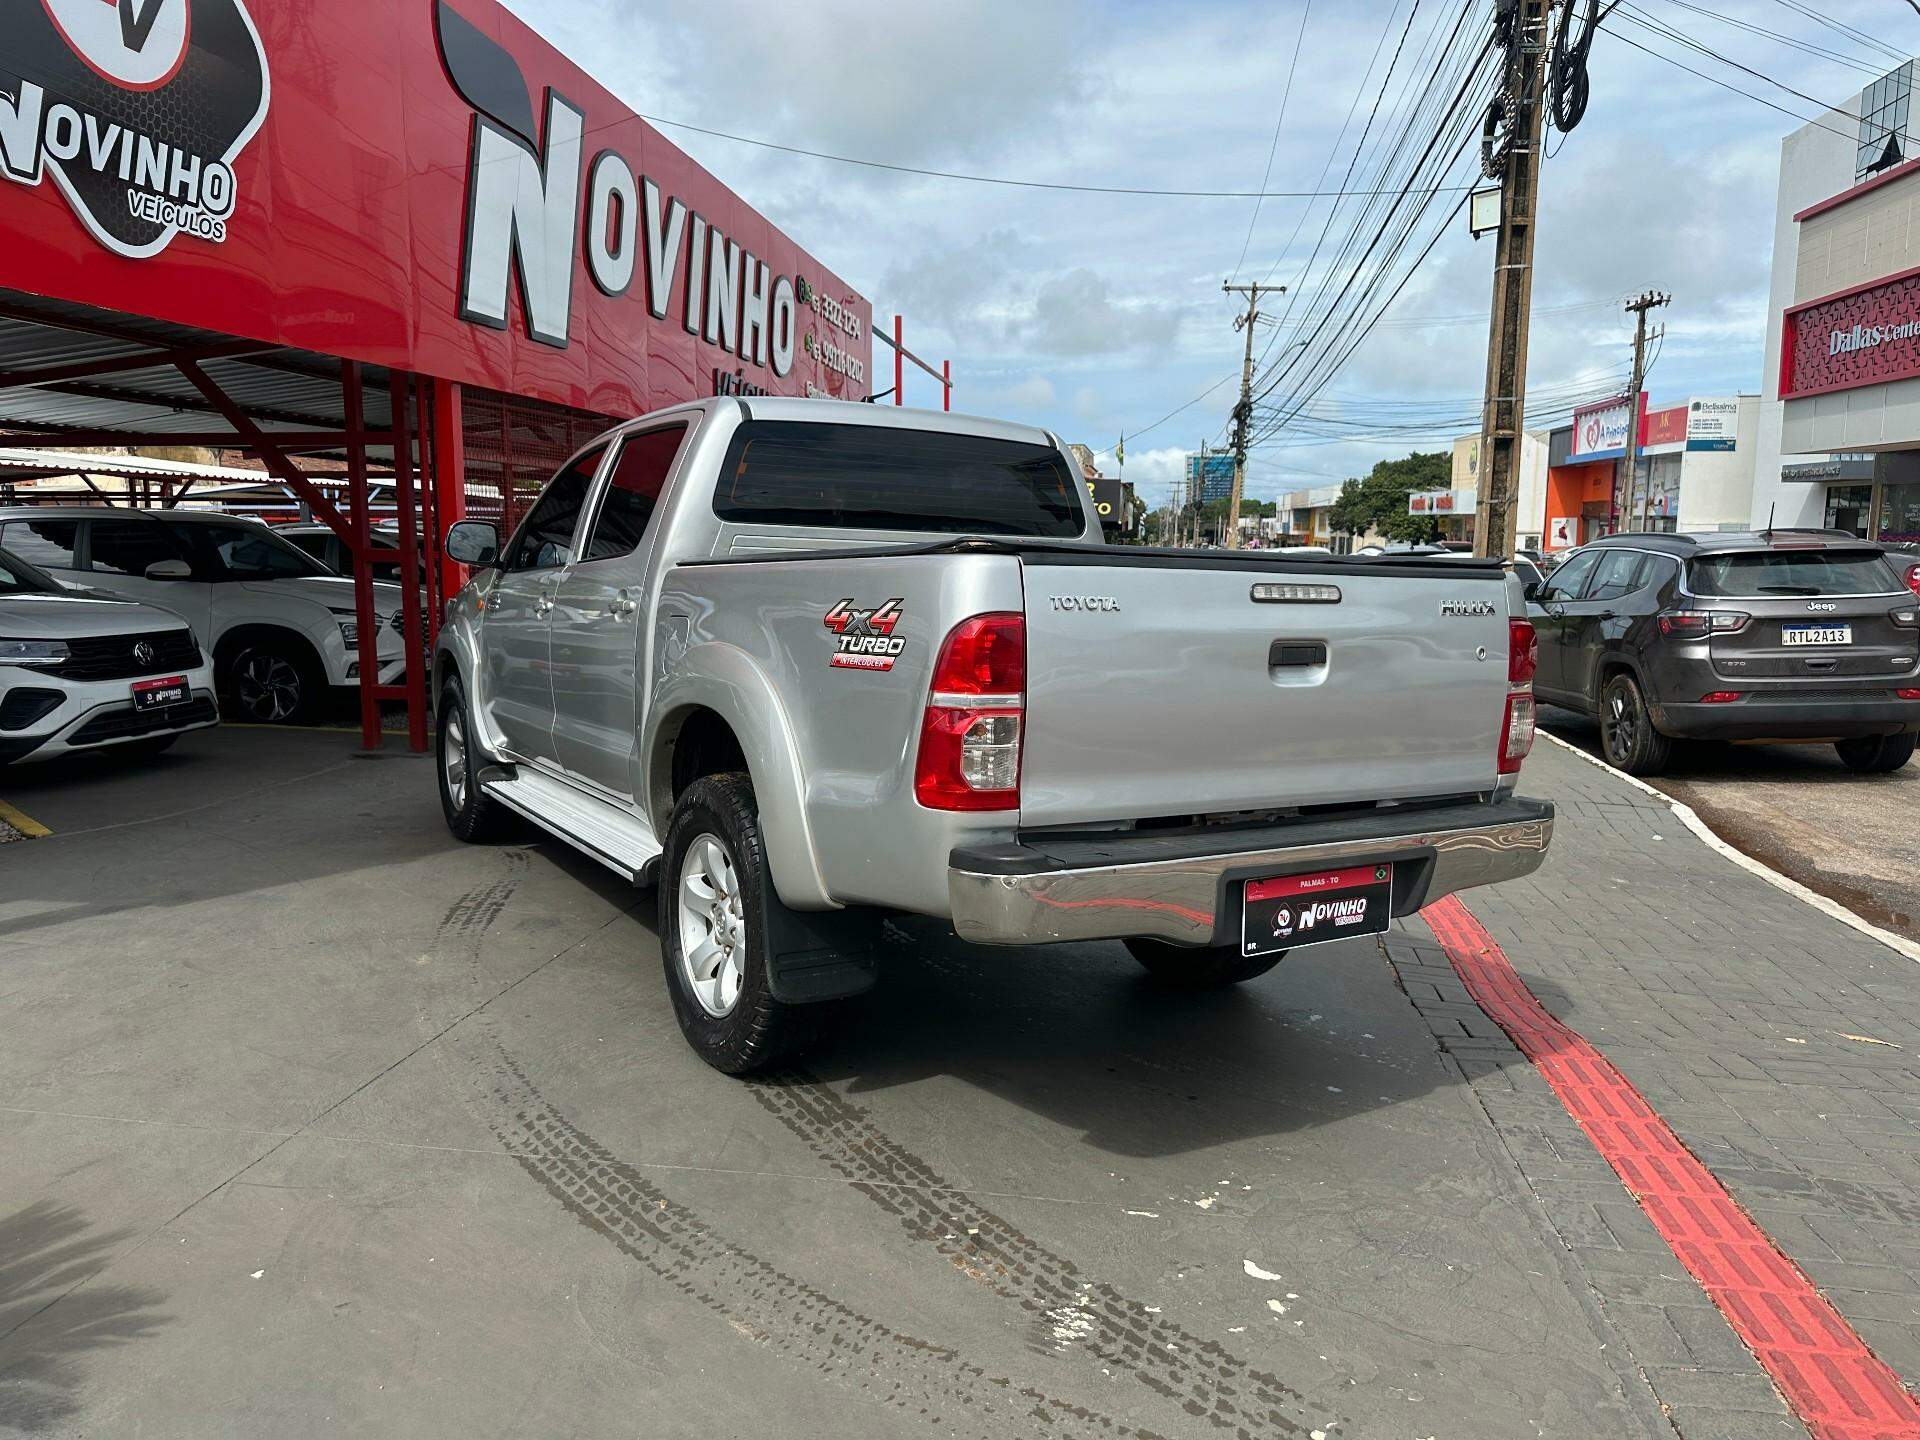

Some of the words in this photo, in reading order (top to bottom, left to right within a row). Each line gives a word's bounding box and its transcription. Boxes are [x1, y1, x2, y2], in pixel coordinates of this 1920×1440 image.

[0, 80, 231, 212] NOVINHO
[130, 191, 224, 239] VEÍCULOS
[456, 86, 795, 378] NOVINHO
[1829, 325, 1881, 356] Dallas
[1049, 595, 1120, 611] TOYOTA
[1439, 600, 1495, 616] HILUX
[1807, 602, 1836, 611] Jeep
[838, 635, 906, 656] TURBO
[1789, 630, 1845, 643] RTL2A13
[1300, 879, 1326, 888] PALMAS
[1330, 876, 1340, 884] TO
[1299, 898, 1367, 930] NOVINHO
[1247, 942, 1257, 951] BR
